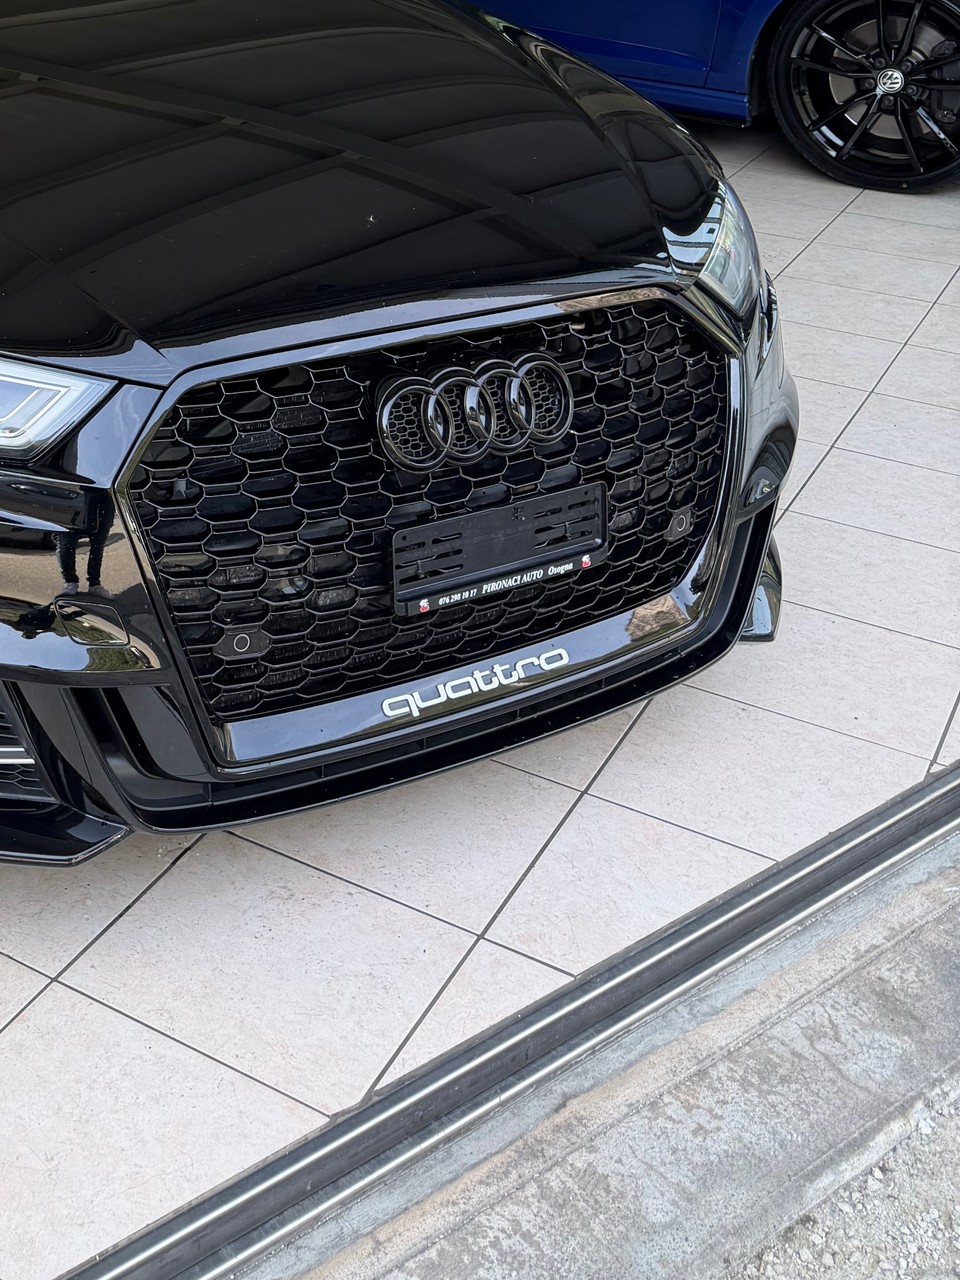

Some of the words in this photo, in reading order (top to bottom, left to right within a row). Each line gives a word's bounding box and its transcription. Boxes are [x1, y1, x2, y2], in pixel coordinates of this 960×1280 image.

[438, 595, 450, 606] 076
[470, 588, 478, 598] 17
[482, 575, 521, 594] PIRONACI
[521, 569, 544, 584] AUTO
[548, 562, 574, 575] Osogna
[381, 648, 570, 718] quattro
